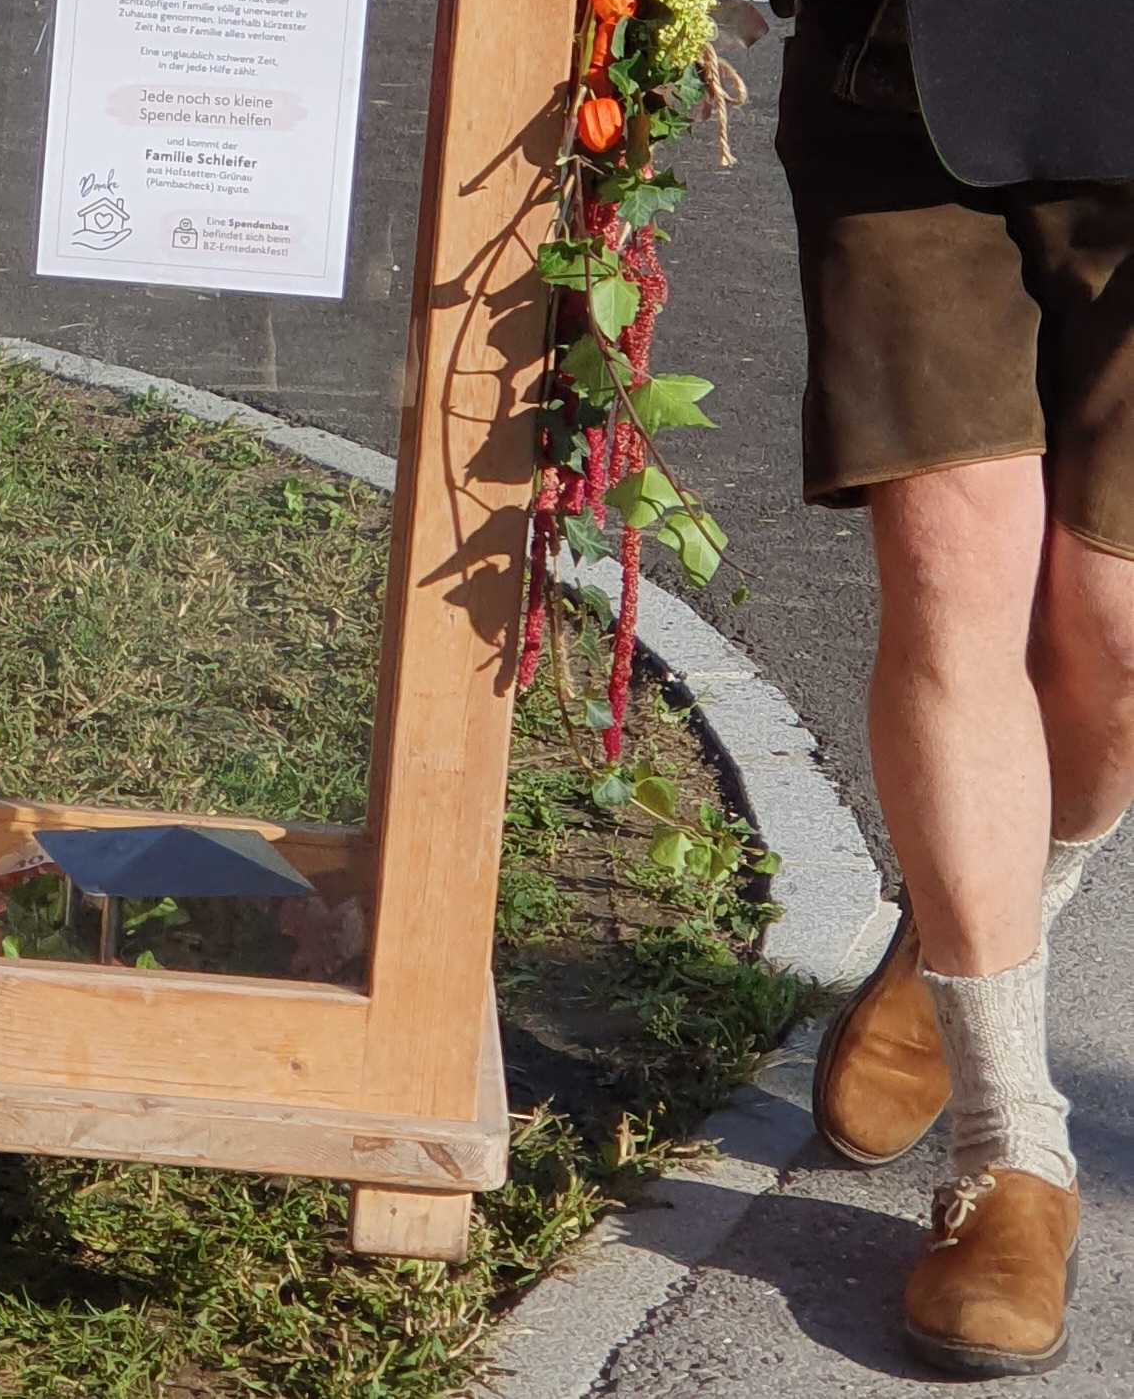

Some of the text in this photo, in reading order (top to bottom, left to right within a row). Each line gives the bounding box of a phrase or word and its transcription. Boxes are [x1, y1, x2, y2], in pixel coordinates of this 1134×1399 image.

[182, 1, 214, 12] Familie
[217, 4, 240, 16] völlig
[243, 7, 293, 19] unerwartet
[118, 8, 306, 31] Zuhause genommen. Innerhalb kürzester
[135, 22, 287, 42] Zeit hat die Familie alles verloren.
[140, 47, 278, 67] Eine unglaublich schwere Zeit,
[169, 61, 184, 71] der
[186, 63, 207, 73] jede
[209, 64, 231, 75] Hilfe
[233, 66, 258, 77] zählt.
[139, 89, 273, 108] Jede noch so kleine
[139, 108, 272, 126] Spende kann helfen
[167, 137, 238, 150] und kommt der
[145, 149, 258, 169] Familie Schleifer
[79, 168, 119, 197] Danke
[147, 166, 253, 182] aus Hofstetten-Grünau
[206, 216, 289, 231] Eine Spendenbox
[203, 229, 291, 244] befindet sich beim
